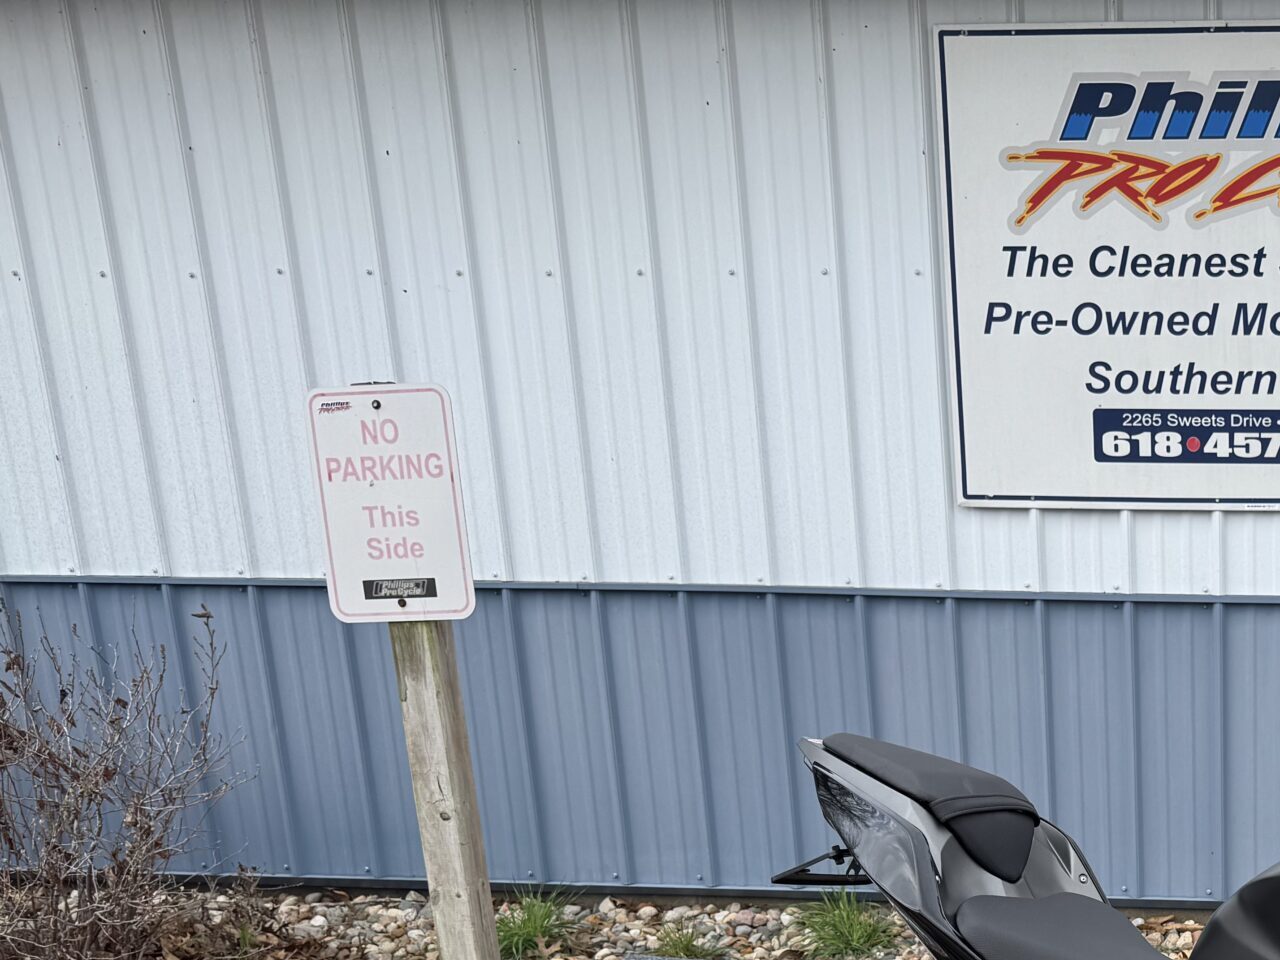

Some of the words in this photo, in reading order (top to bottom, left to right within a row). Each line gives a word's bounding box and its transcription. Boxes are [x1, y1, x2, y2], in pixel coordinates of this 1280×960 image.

[1007, 147, 1223, 227] PRO
[1001, 245, 1074, 278] The
[1088, 244, 1267, 278] Cleanest
[983, 301, 1220, 336] Pre-Owned
[1085, 360, 1278, 395] Southern
[360, 418, 400, 446] NO
[1122, 413, 1162, 427] 2265
[1166, 413, 1226, 428] Sweets
[1230, 413, 1273, 428] Drive
[325, 452, 444, 482] PARKING
[361, 505, 421, 529] This
[366, 536, 425, 561] Side
